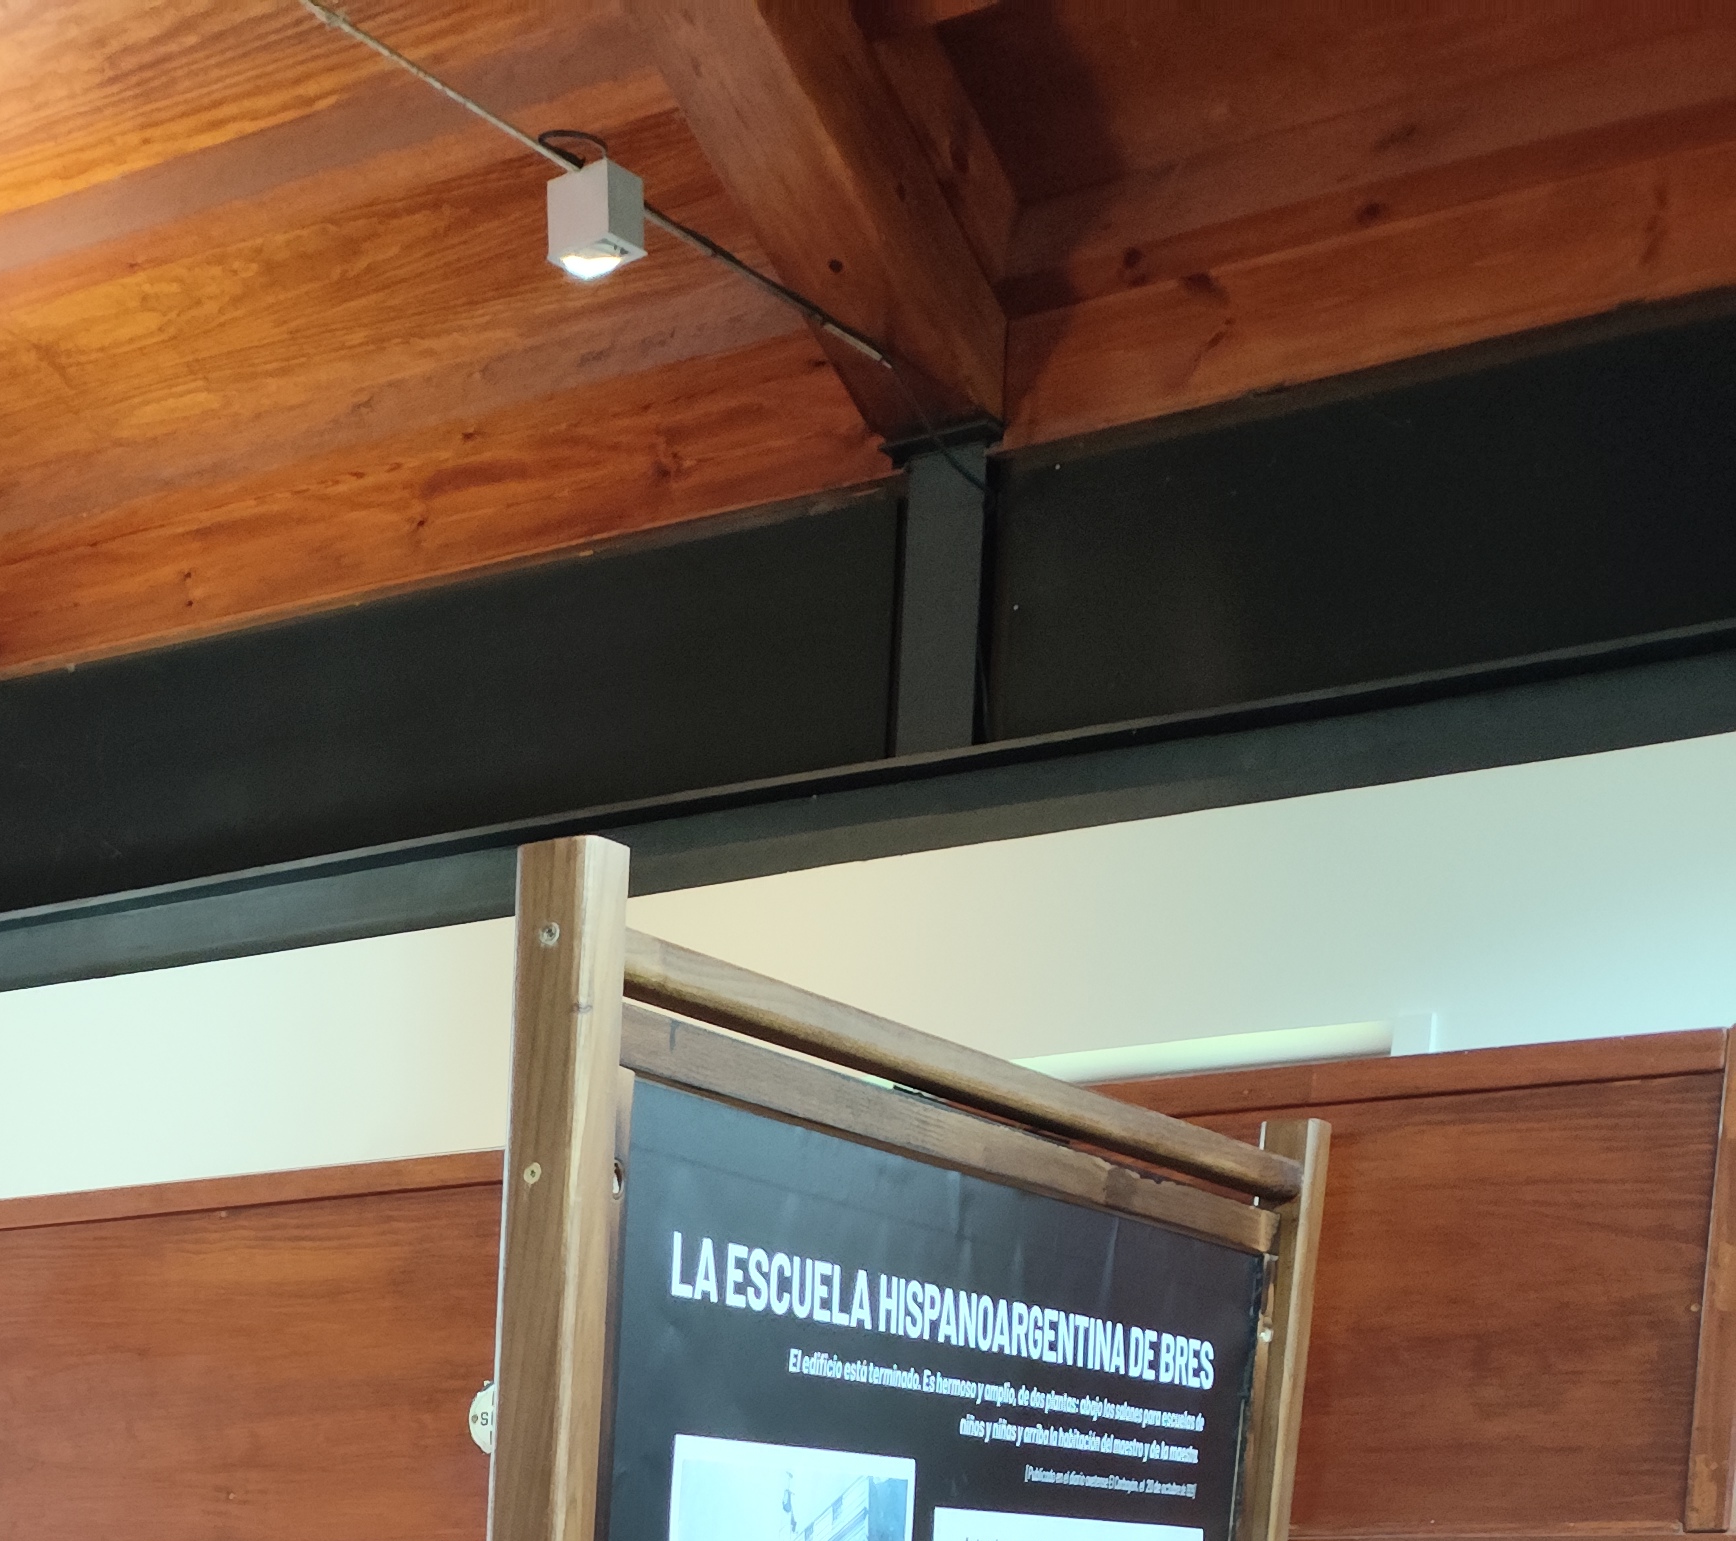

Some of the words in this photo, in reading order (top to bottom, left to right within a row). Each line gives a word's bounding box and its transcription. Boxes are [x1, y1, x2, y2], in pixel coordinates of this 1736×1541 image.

[671, 1230, 718, 1303] LA
[725, 1242, 872, 1330] ESCUELA
[878, 1273, 1125, 1375] HISPANOARGENTINA
[1128, 1326, 1156, 1381] DE
[1159, 1332, 1215, 1390] BRES
[789, 1349, 802, 1372] El
[803, 1352, 842, 1378] edificio
[844, 1360, 867, 1382] está
[868, 1363, 921, 1390] terminado.
[923, 1369, 935, 1392] Es
[936, 1372, 976, 1398] hermoso
[976, 1383, 984, 1404] y
[984, 1382, 1016, 1406] amplio,
[1018, 1385, 1029, 1406] de
[1030, 1387, 1045, 1408] dos
[984, 1422, 992, 1442] y
[1016, 1426, 1024, 1446] y
